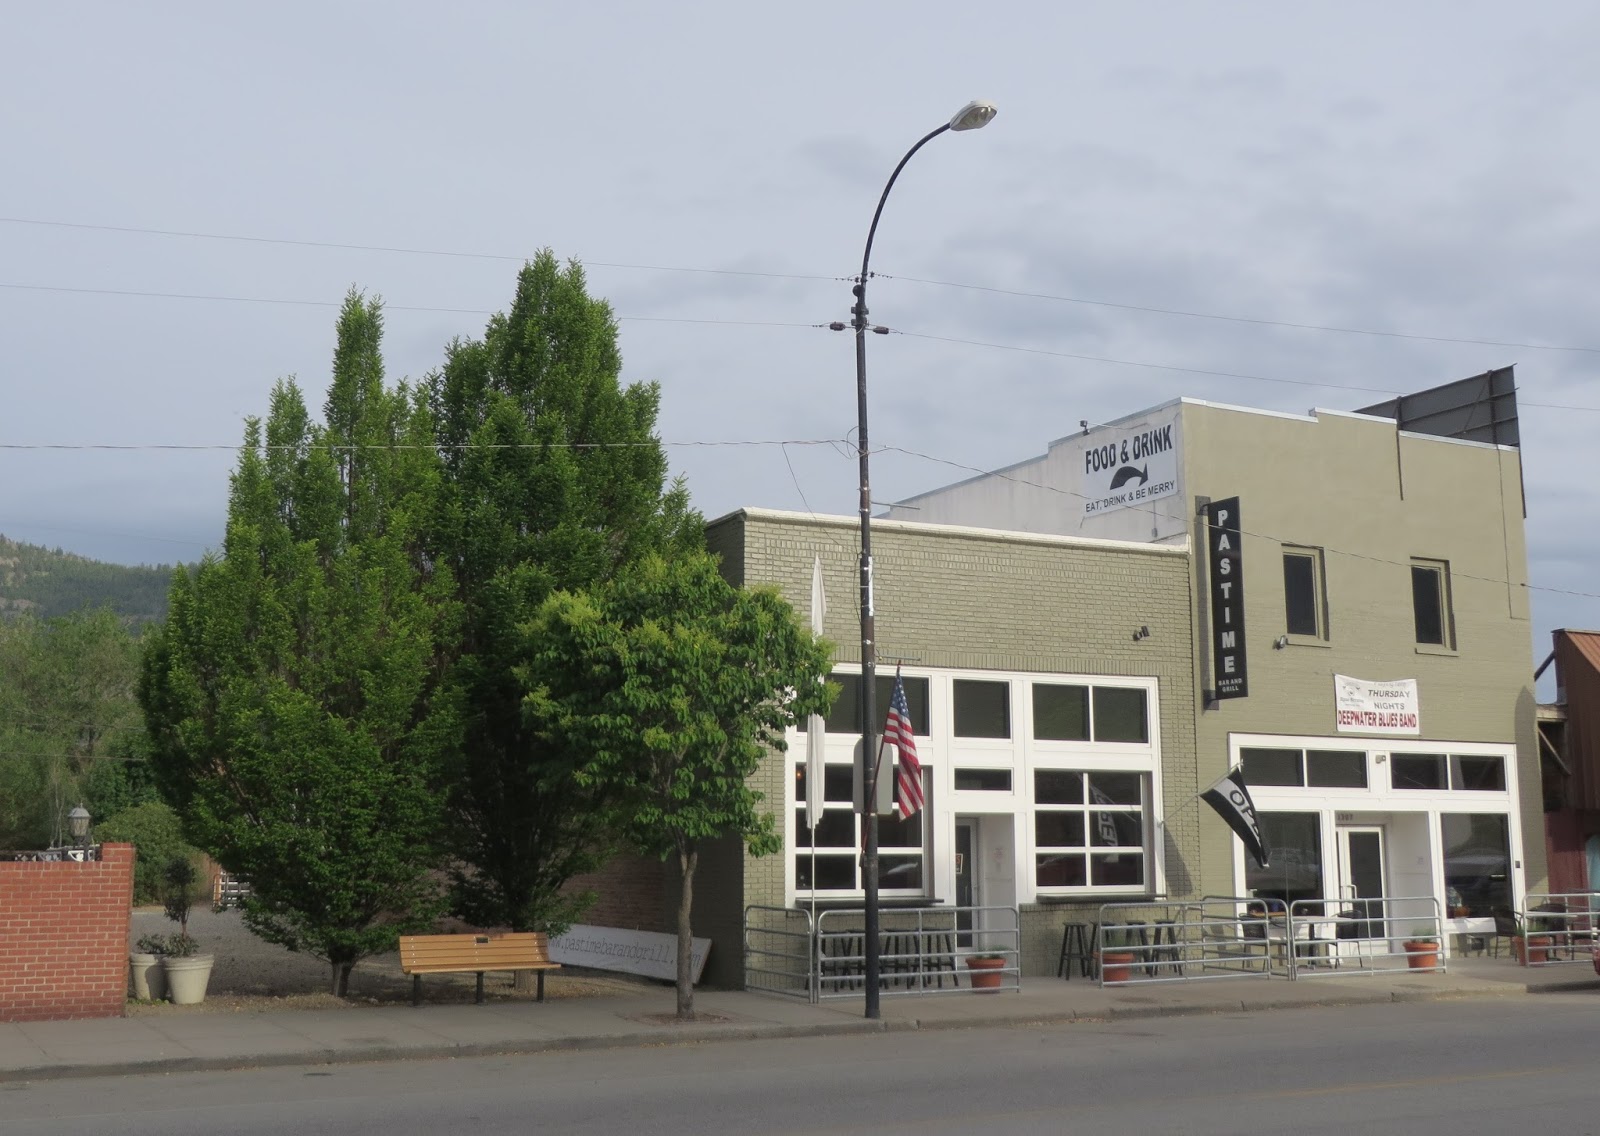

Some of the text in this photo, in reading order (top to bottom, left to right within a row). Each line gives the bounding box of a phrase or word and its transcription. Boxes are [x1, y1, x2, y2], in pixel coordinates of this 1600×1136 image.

[1085, 424, 1173, 474] FOOD & DRINK
[1103, 494, 1127, 508] DRINK
[1128, 491, 1134, 501] &
[1135, 488, 1146, 500] BE
[1148, 480, 1175, 496] MERRY
[1217, 509, 1235, 673] PASTIME
[1230, 677, 1243, 685] AND
[1222, 685, 1239, 693] GRILL
[1368, 689, 1411, 698] THURSDAY
[1373, 702, 1405, 710] NIGHTS
[1338, 710, 1417, 728] DEEPWATER BLUES BAND
